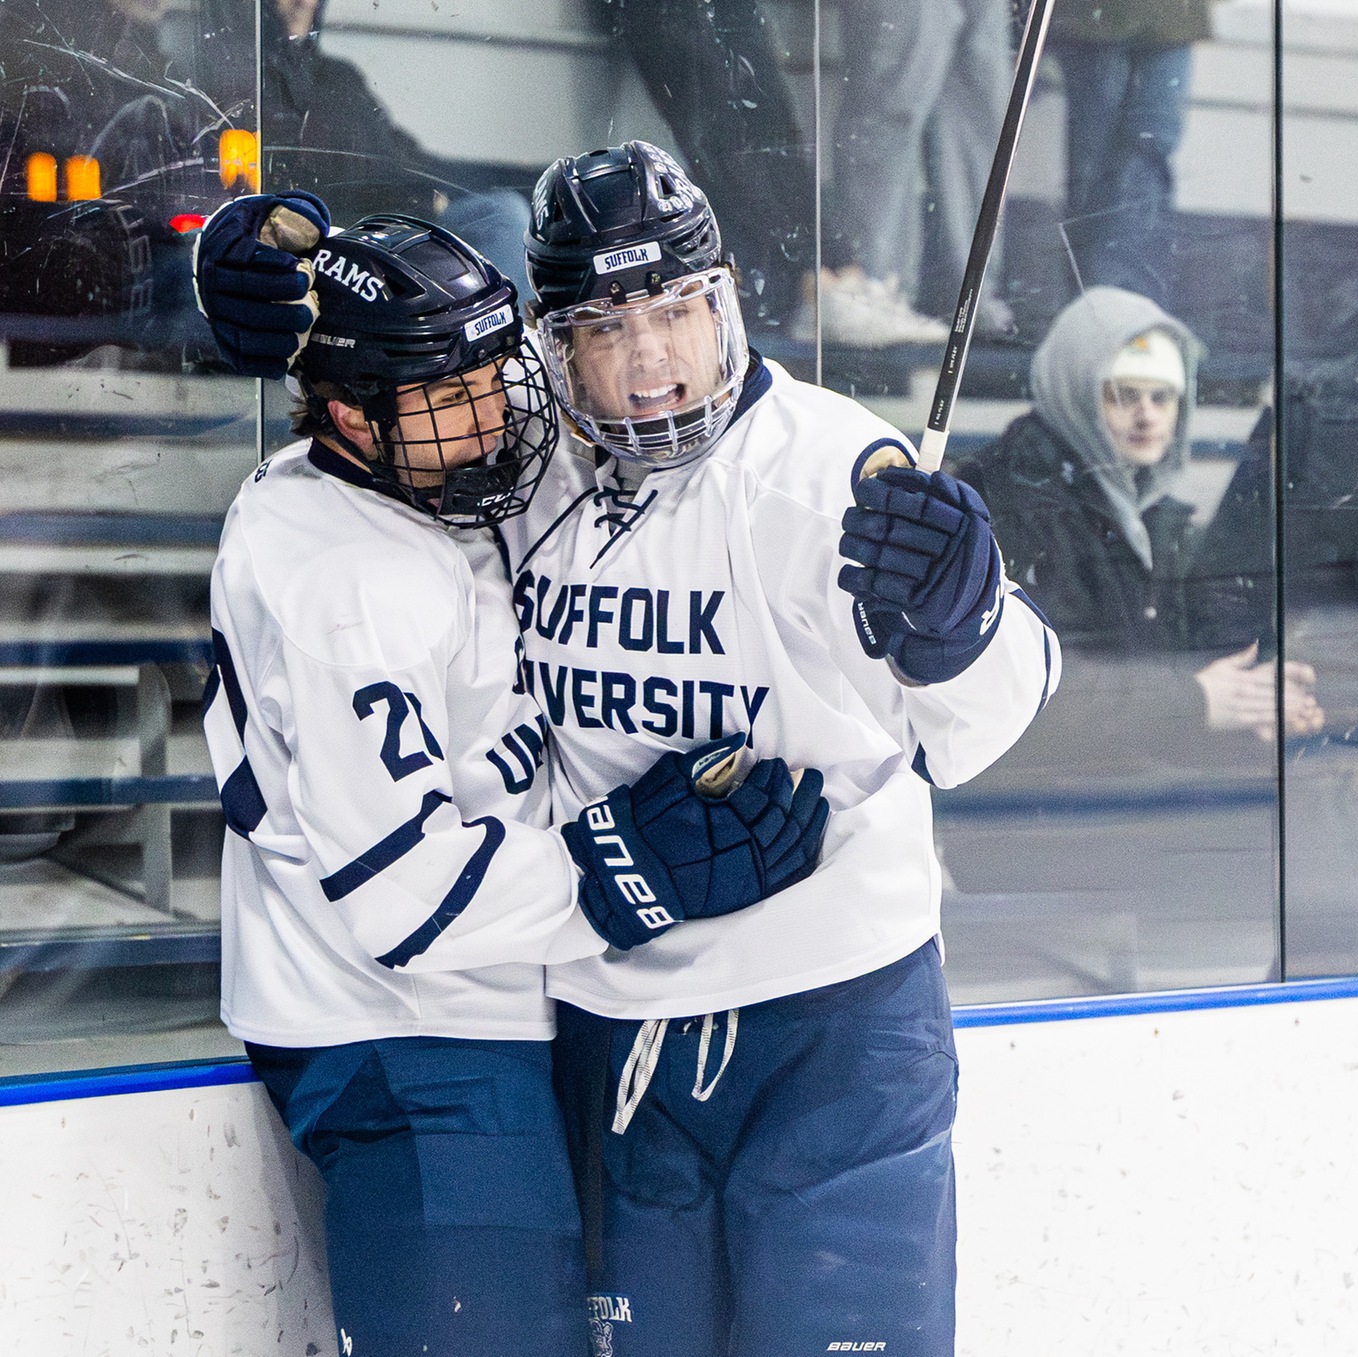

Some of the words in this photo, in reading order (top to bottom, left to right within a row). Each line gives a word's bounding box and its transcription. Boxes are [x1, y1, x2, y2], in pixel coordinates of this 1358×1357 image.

[311, 249, 384, 302] RAMS
[604, 248, 649, 270] SUFFOLK
[474, 311, 507, 336] SUFFOLK
[513, 569, 726, 655] SUFFOLK
[587, 796, 677, 929] BAUE
[826, 1341, 887, 1352] BAUER
